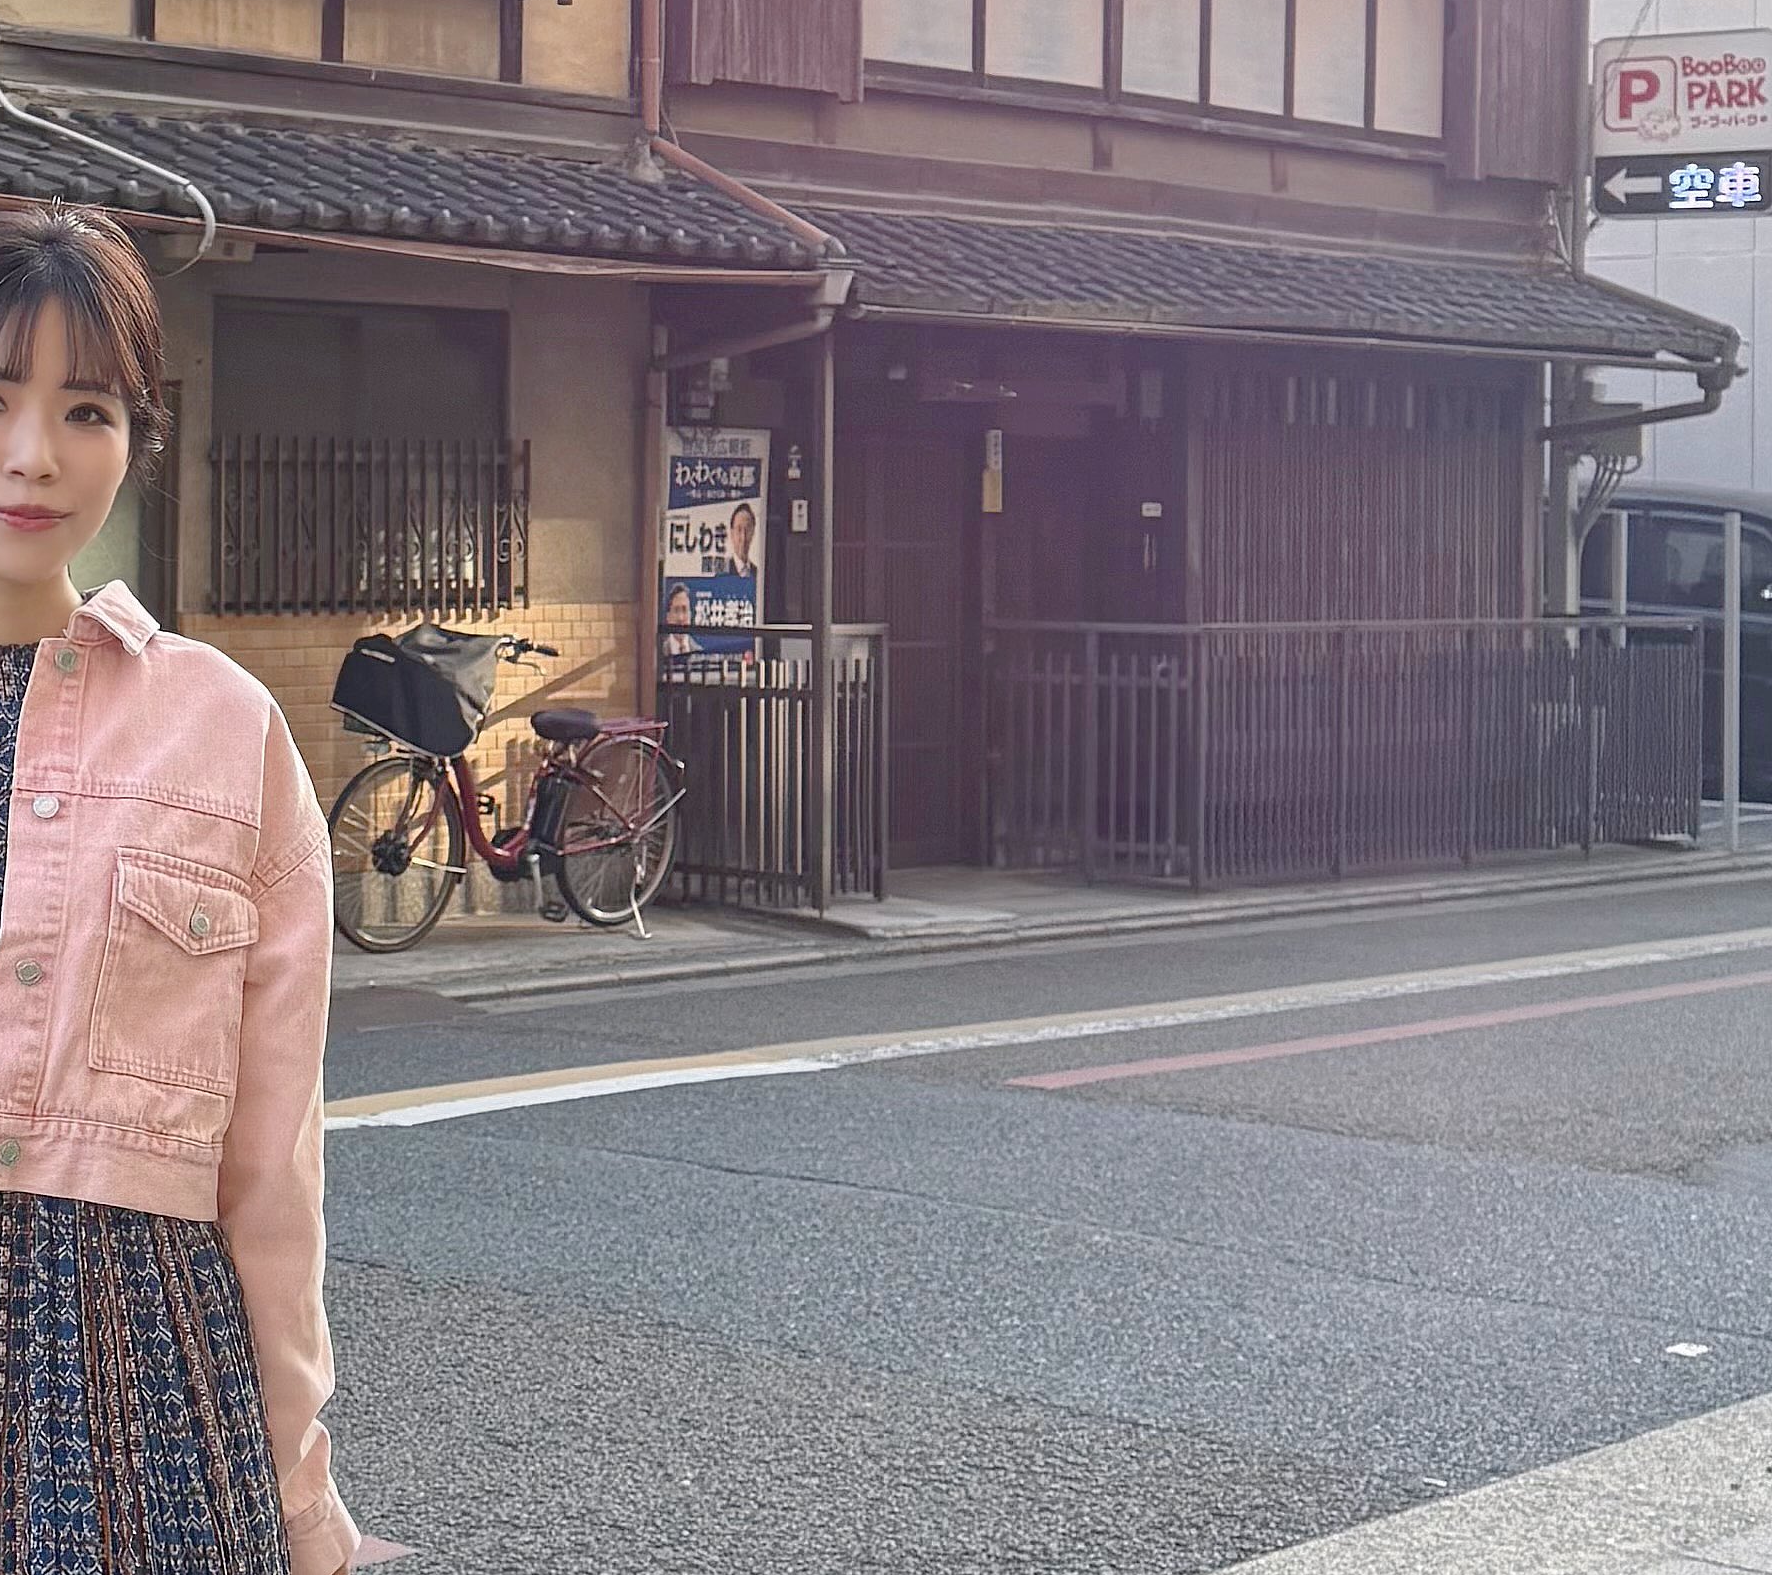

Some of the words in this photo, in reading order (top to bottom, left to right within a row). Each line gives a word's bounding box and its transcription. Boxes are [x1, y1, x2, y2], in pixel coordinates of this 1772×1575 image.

[1681, 53, 1766, 76] BooBoo
[1619, 70, 1660, 120] P
[1687, 78, 1768, 111] PARK
[1669, 161, 1762, 210] 空車
[669, 523, 727, 554] にしわき
